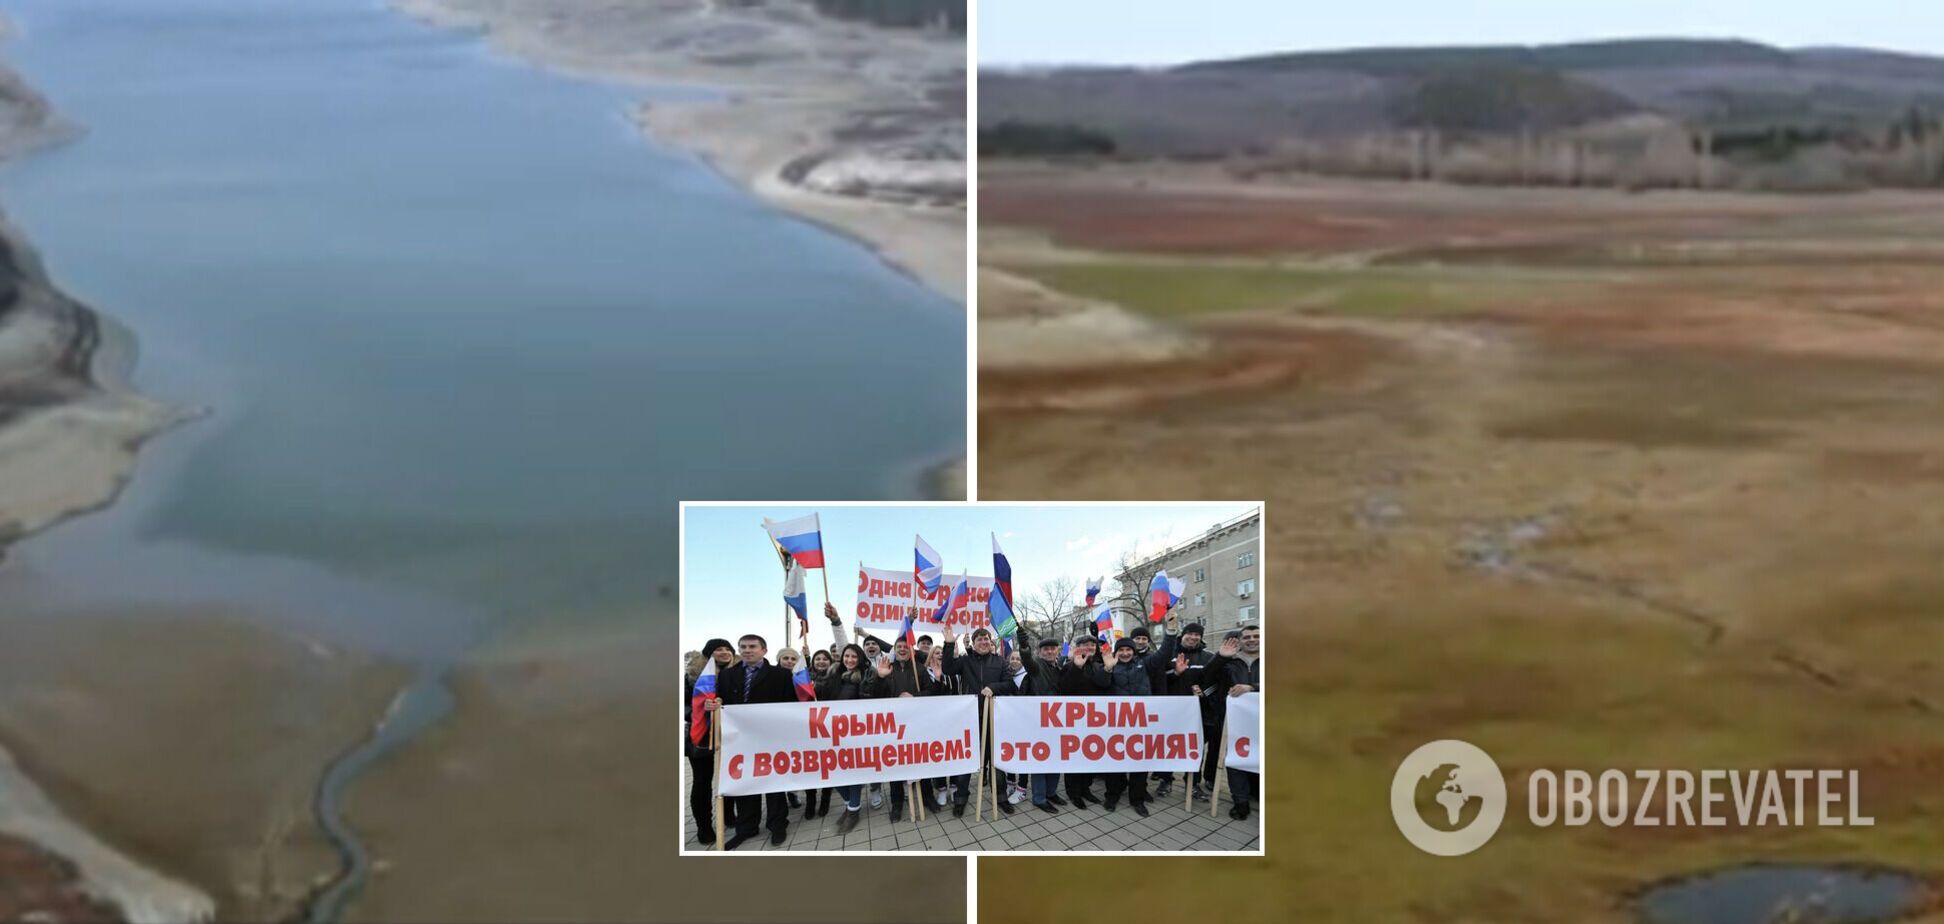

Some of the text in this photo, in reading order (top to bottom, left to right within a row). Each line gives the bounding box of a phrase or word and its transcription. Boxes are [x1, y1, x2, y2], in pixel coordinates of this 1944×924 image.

[917, 583, 990, 606] срна
[918, 606, 991, 629] нрод!
[808, 706, 906, 746] Крым,
[1040, 701, 1159, 728] КРЫМ-
[752, 729, 972, 780] возвращением!
[1001, 733, 1199, 762] это РОССИЯ!
